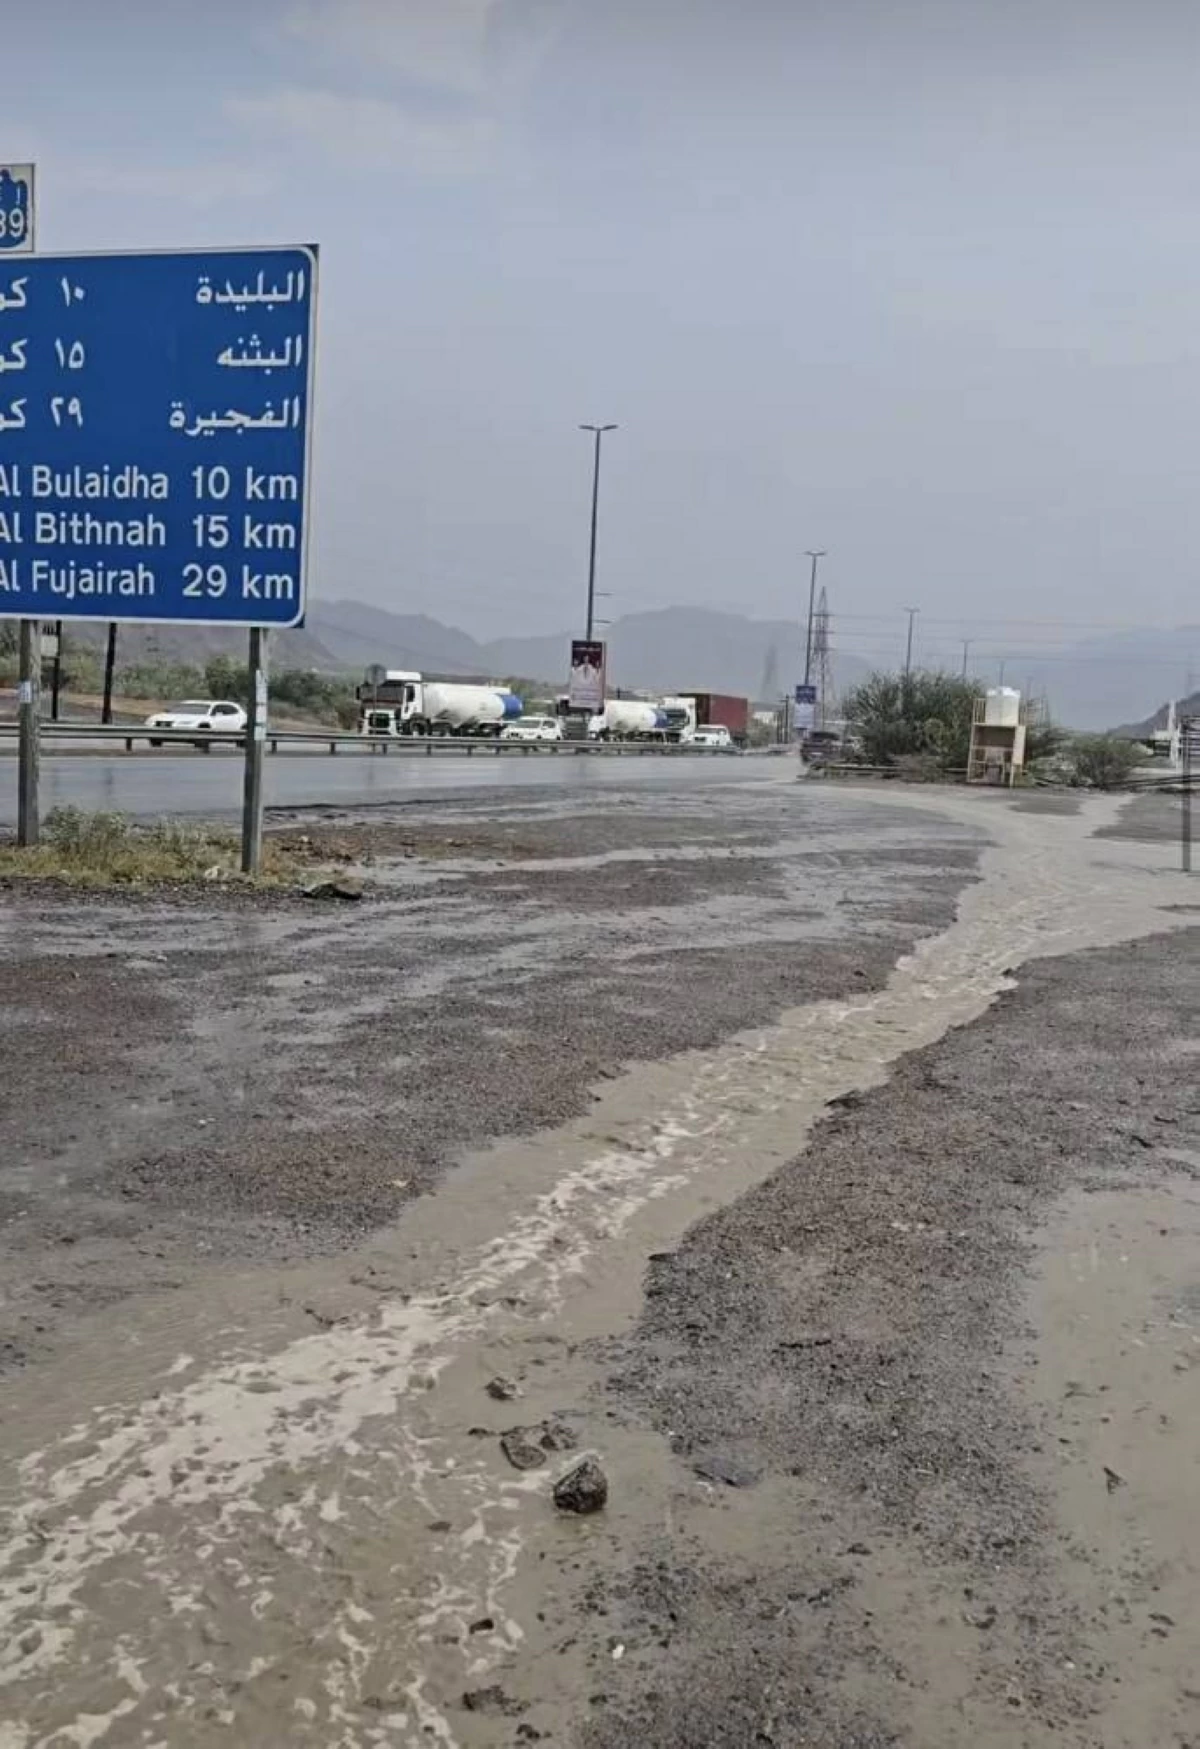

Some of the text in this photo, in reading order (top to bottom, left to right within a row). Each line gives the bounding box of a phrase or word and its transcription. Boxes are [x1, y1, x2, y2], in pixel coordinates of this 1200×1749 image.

[61, 276, 84, 306] ١٠
[195, 270, 304, 312] البليدة
[55, 338, 84, 369] ١٥
[216, 334, 303, 375] البثنه
[51, 397, 83, 426] ٢٩
[169, 396, 301, 437] الفجيرة
[32, 465, 169, 499] Bulaidha
[192, 466, 230, 499] 10
[246, 467, 298, 500] km
[35, 512, 166, 546] Bithnah
[193, 515, 230, 548] 15
[244, 515, 296, 549] km
[32, 560, 155, 599] Fujairah
[182, 563, 227, 597] 29
[242, 565, 294, 600] km
